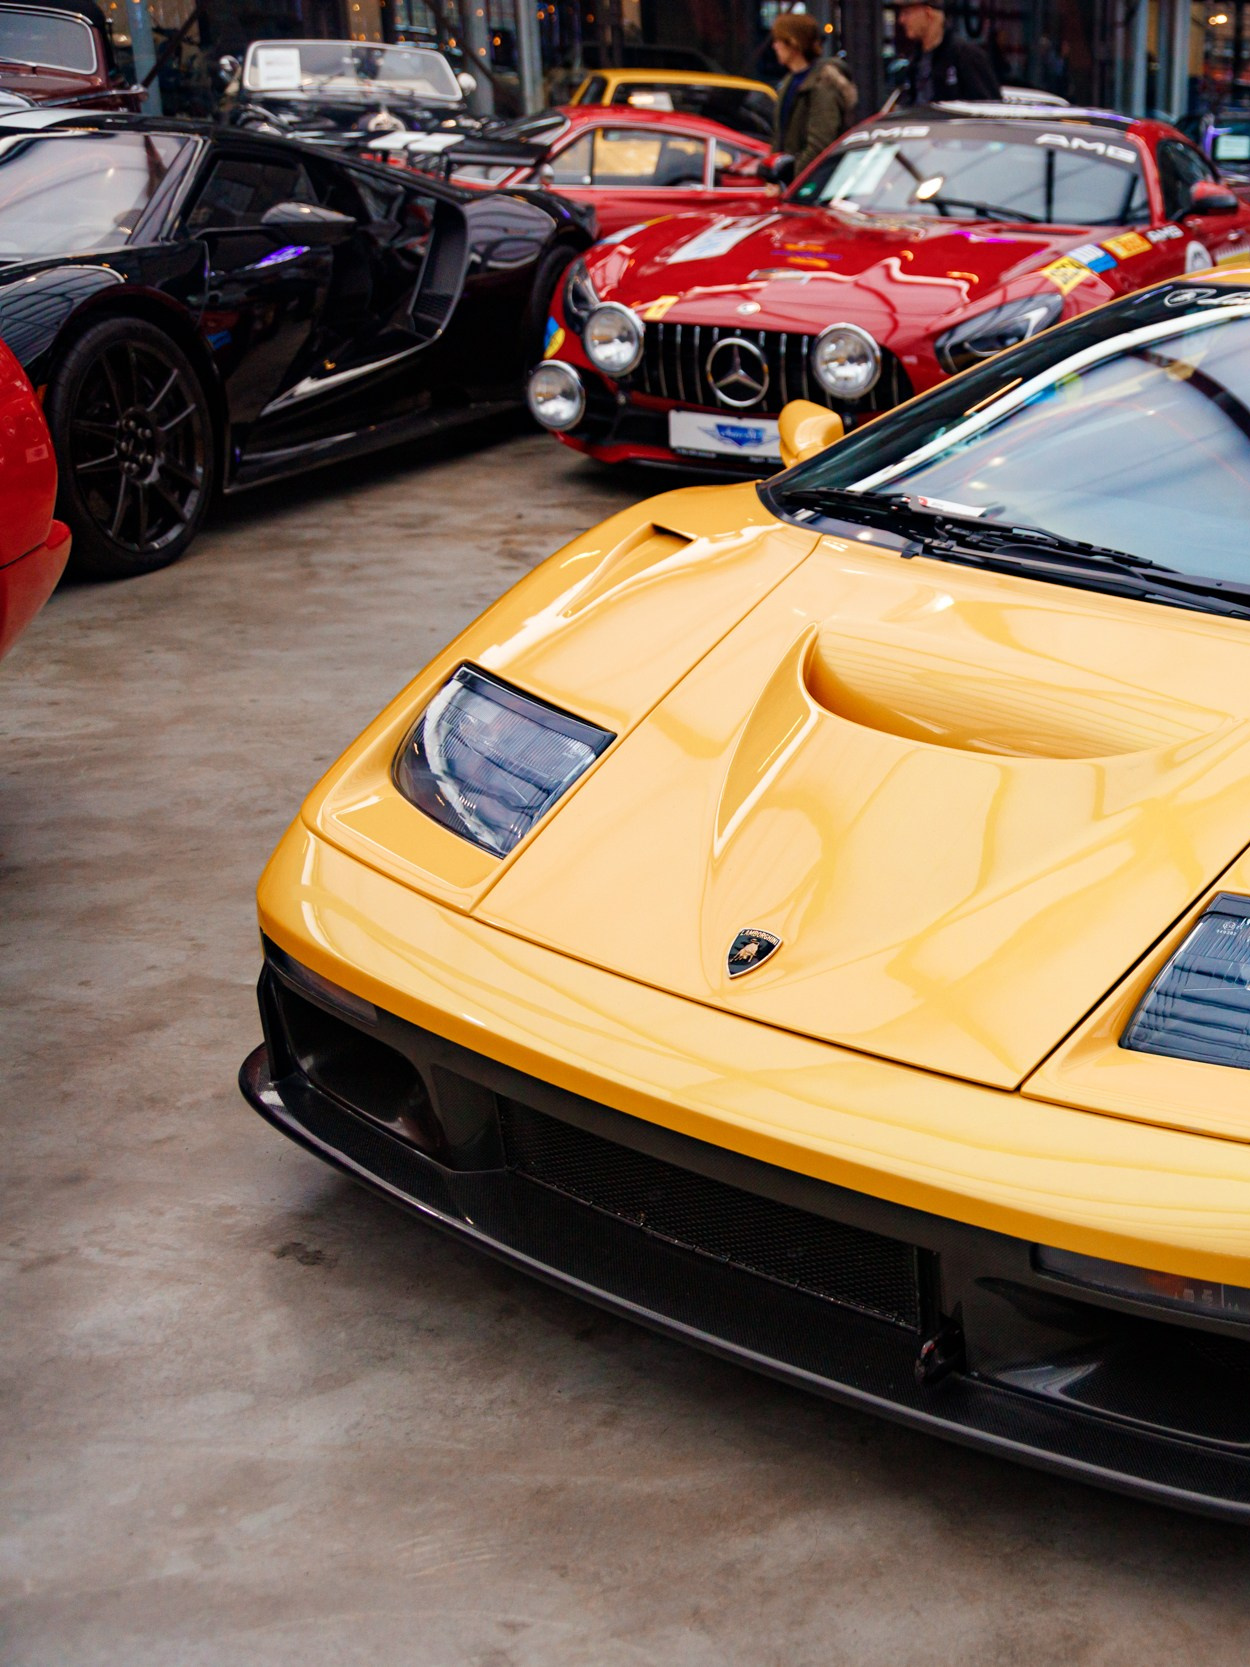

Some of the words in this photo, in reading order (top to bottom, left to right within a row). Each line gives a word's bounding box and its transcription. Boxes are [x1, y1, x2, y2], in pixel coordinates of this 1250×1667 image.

[842, 126, 930, 146] AMG
[1035, 133, 1137, 163] AMG
[740, 929, 779, 946] LAMBORGHINI
